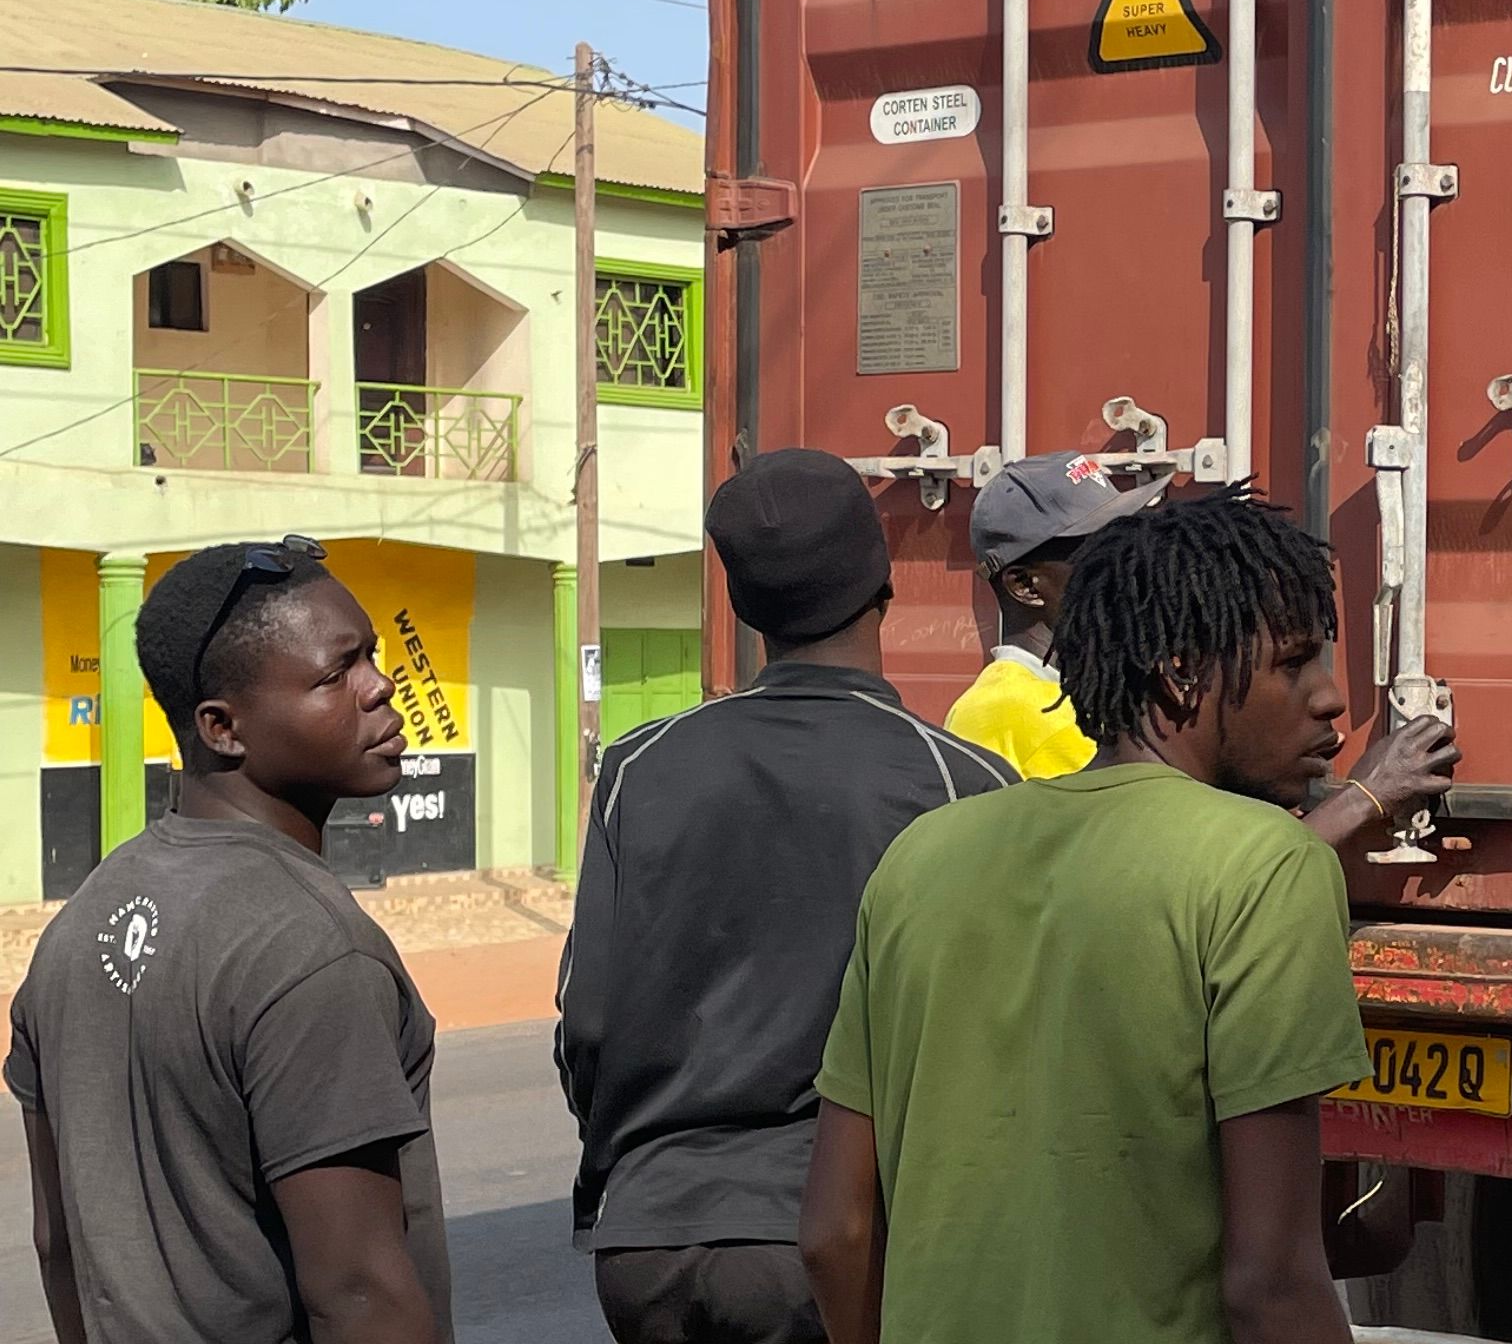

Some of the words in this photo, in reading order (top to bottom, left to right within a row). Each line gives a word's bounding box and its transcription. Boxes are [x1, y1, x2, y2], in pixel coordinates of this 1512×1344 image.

[1122, 1, 1165, 18] SUPER
[1125, 22, 1167, 39] HEAVY
[882, 97, 928, 116] CORTEN
[931, 92, 968, 111] STEEL
[893, 115, 957, 136] CONTAINER
[393, 607, 460, 744] WESTERN
[391, 664, 435, 748] UNION
[1349, 1036, 1485, 1103] 042Q
